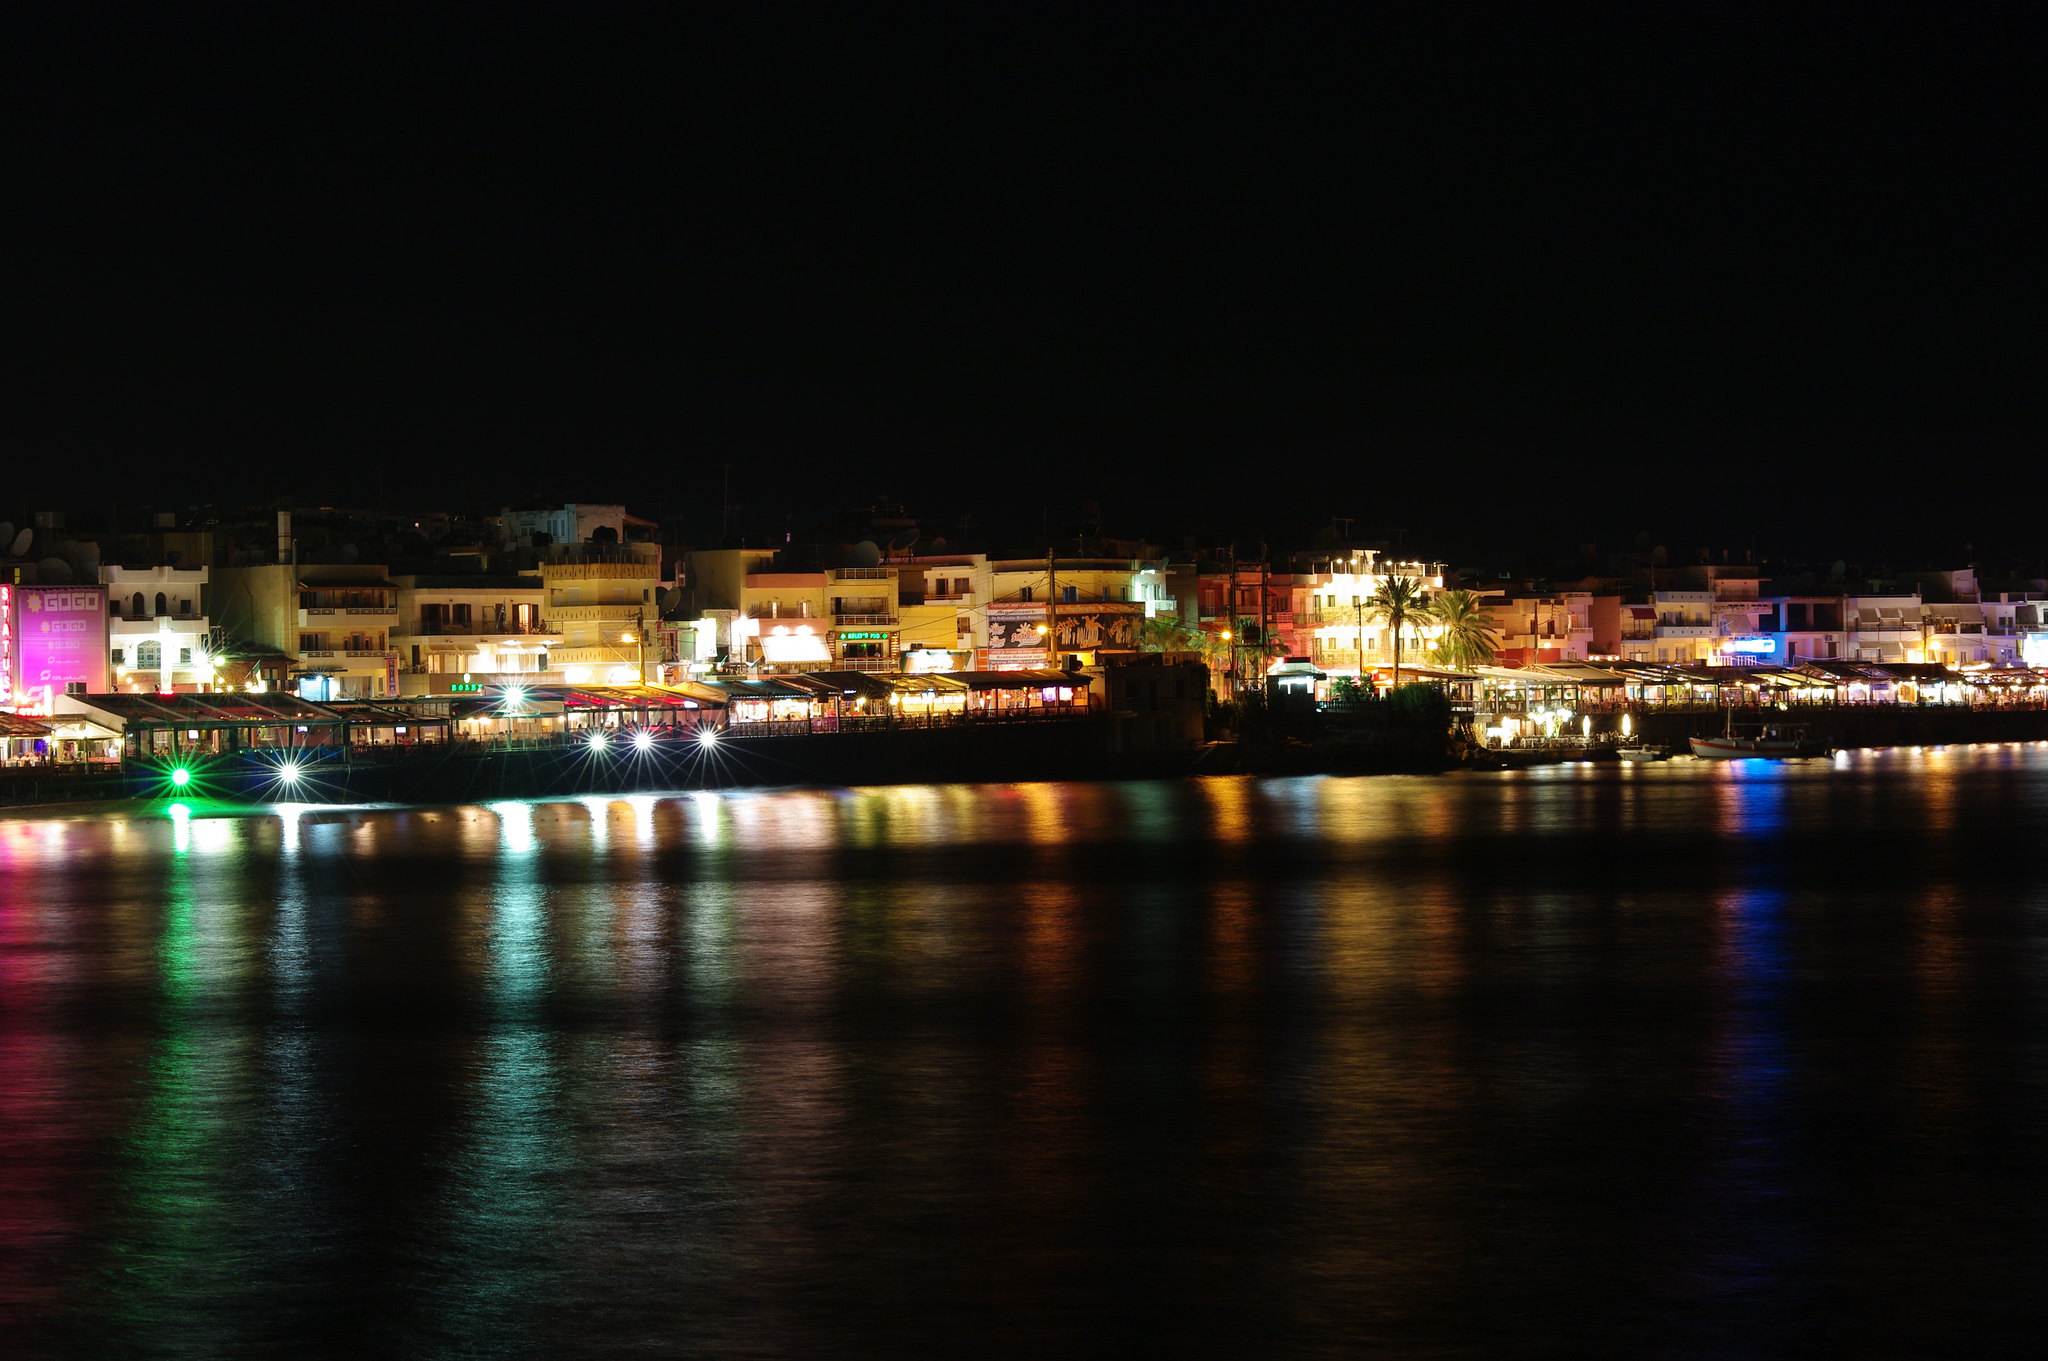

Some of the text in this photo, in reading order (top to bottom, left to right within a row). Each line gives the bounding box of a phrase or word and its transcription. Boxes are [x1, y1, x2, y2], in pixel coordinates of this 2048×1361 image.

[44, 593, 99, 612] GOGO
[51, 620, 87, 632] GOGO
[2, 586, 12, 687] STATUS
